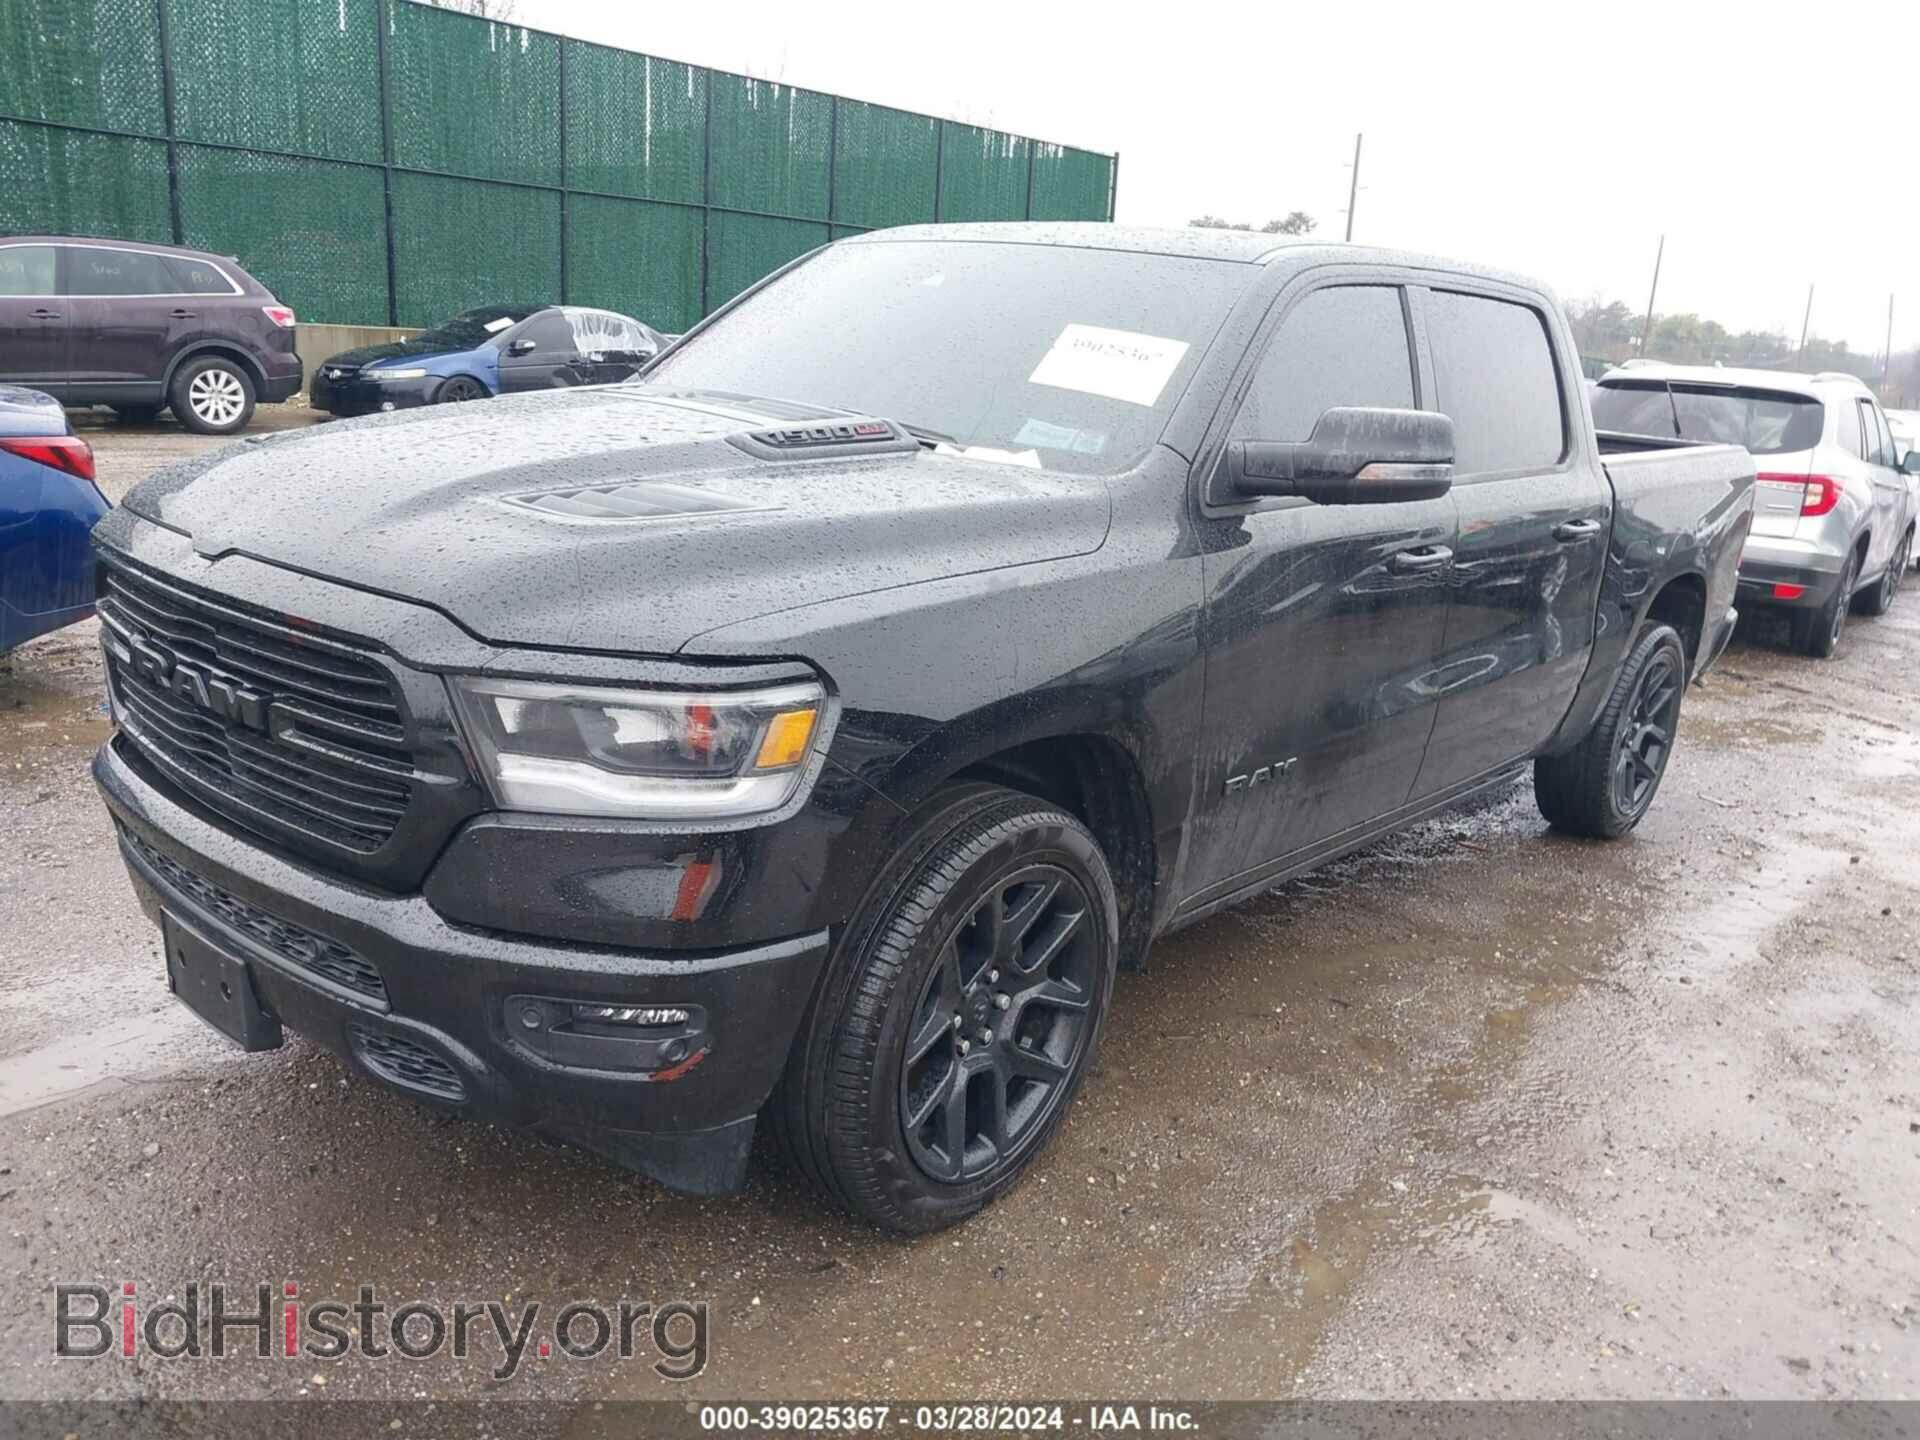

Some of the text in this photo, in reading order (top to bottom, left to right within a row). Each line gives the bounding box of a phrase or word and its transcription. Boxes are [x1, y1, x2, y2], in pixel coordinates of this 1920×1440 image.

[768, 426, 854, 443] 1500
[132, 640, 268, 732] RAM
[1224, 757, 1298, 796] RAM
